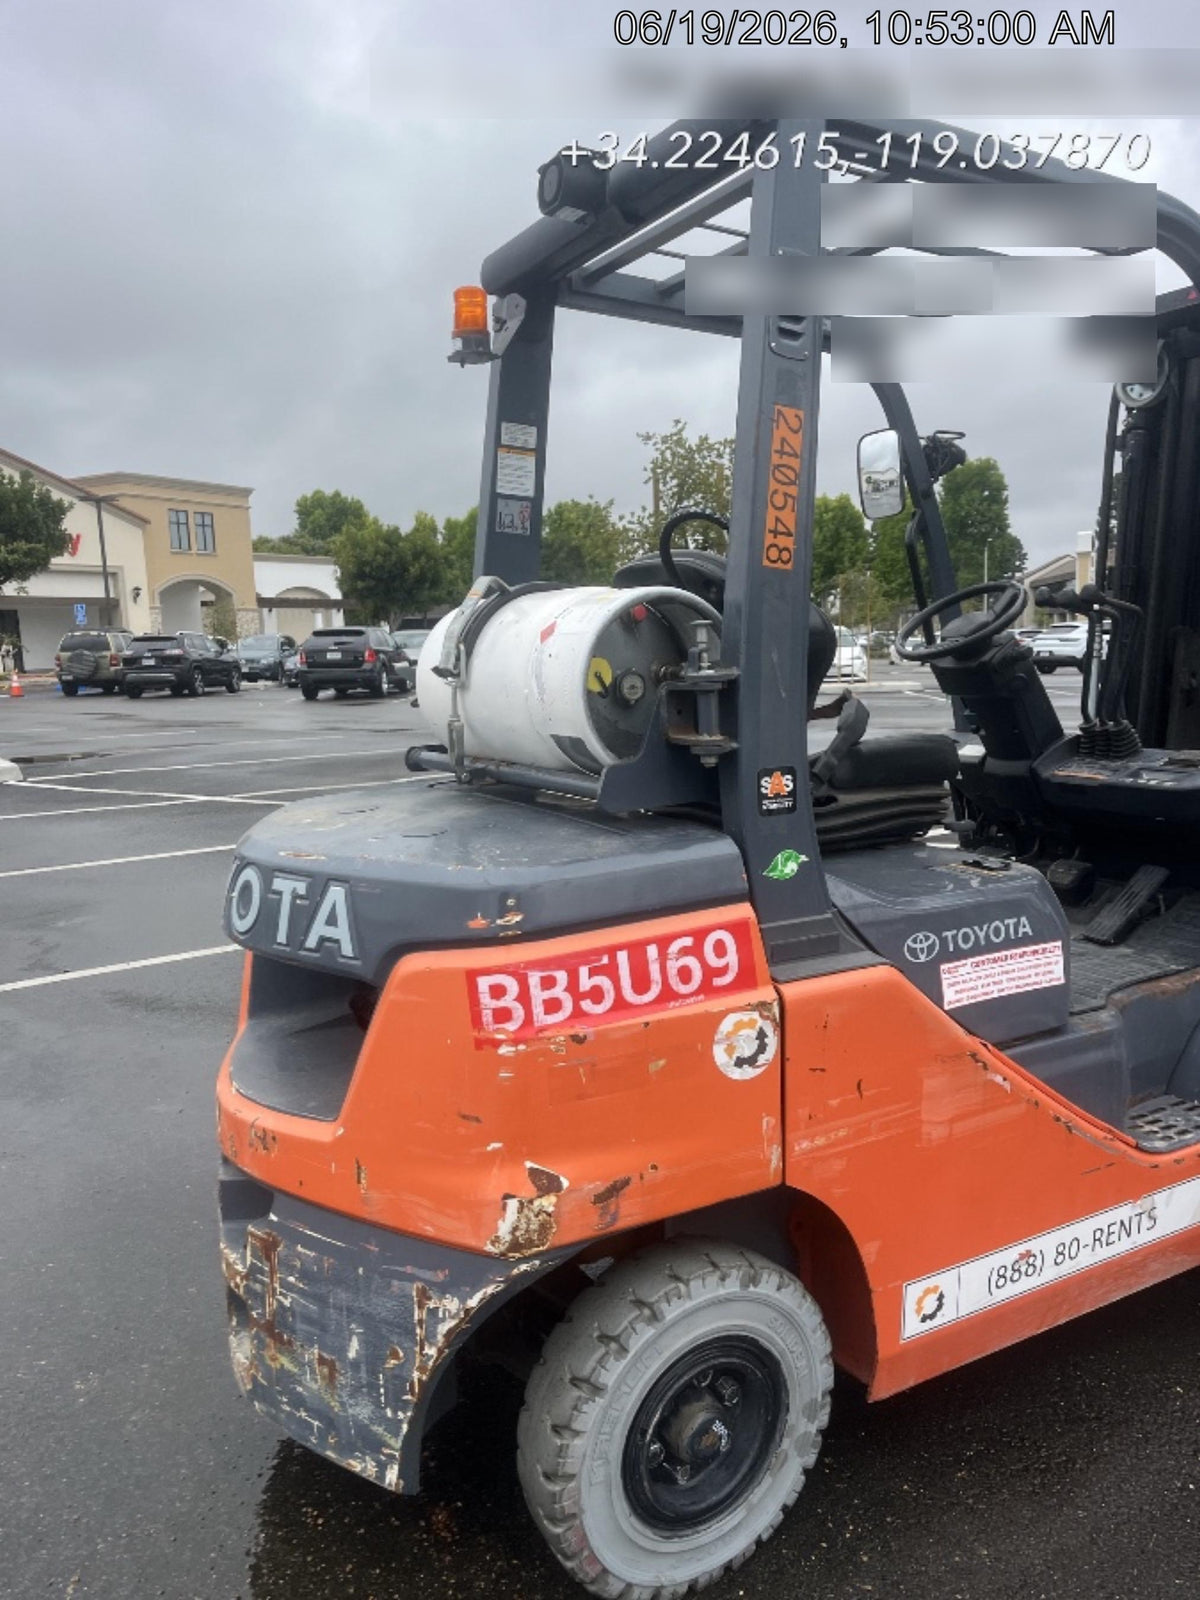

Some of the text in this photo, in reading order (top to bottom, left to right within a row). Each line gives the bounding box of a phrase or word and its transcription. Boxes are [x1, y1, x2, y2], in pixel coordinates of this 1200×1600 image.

[765, 408, 803, 566] 240548
[476, 929, 740, 1034] BB5U69
[942, 916, 1033, 952] TOYOTA
[987, 1206, 1158, 1297] (888) 80-RENTS
